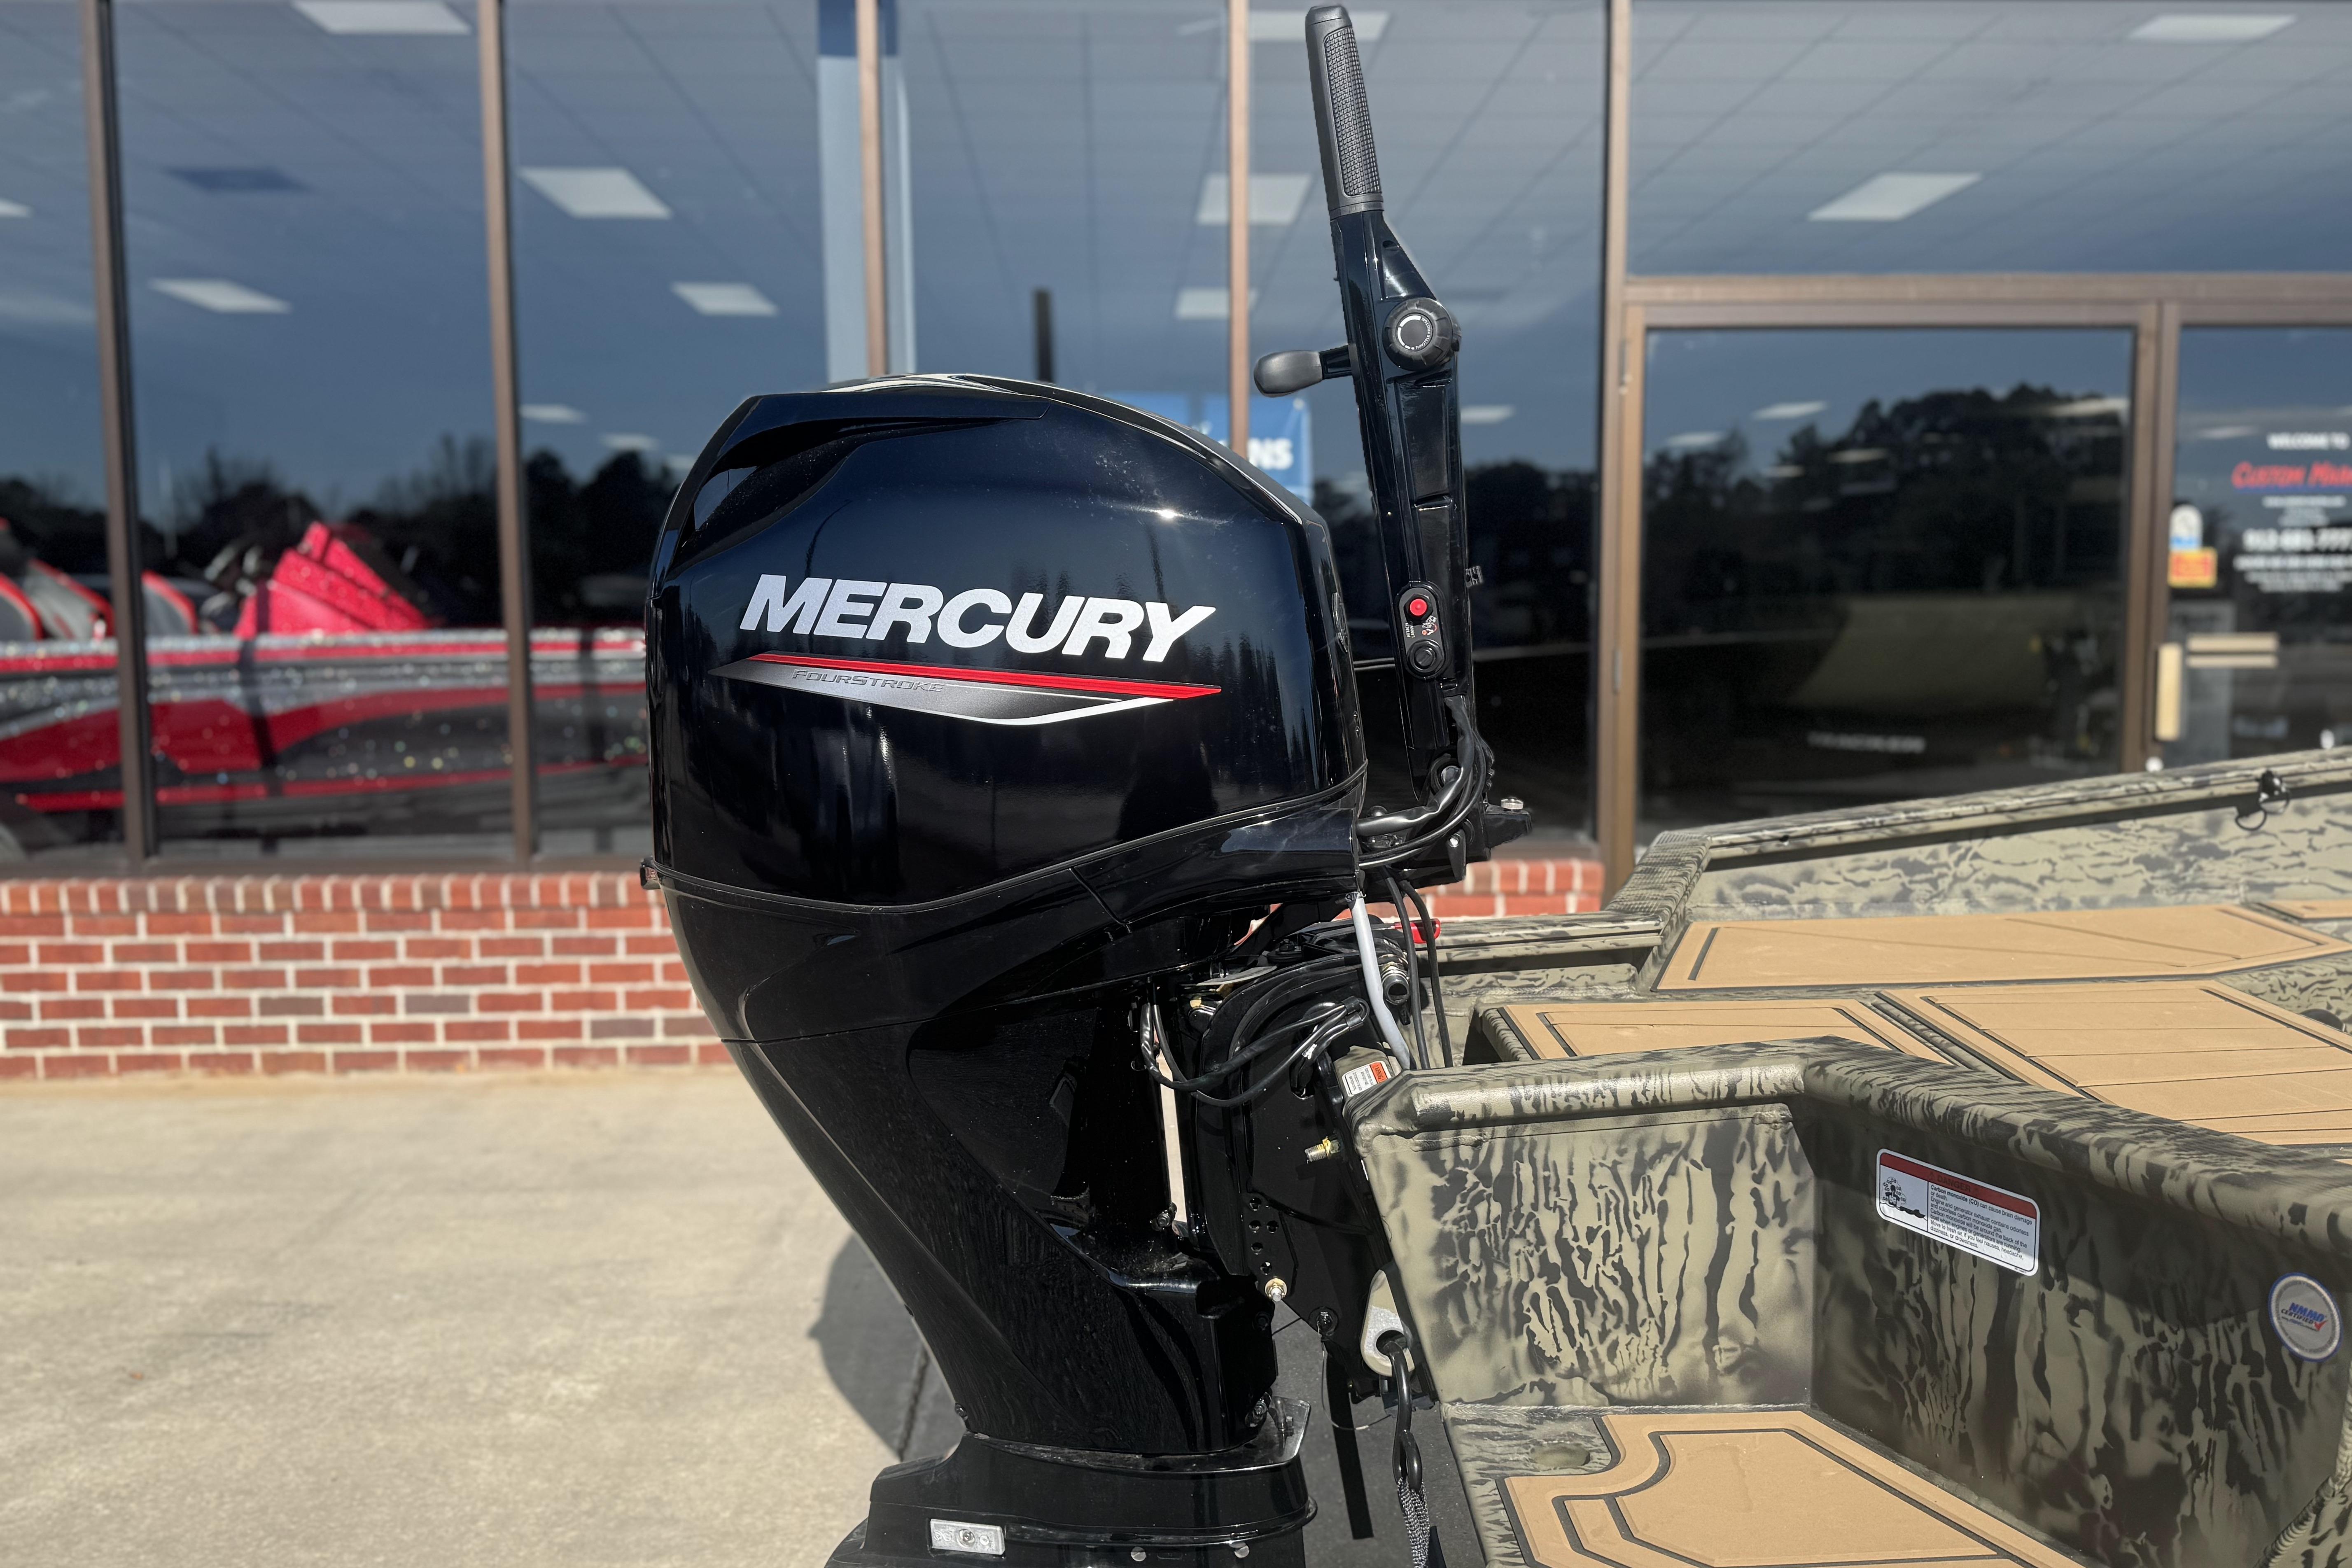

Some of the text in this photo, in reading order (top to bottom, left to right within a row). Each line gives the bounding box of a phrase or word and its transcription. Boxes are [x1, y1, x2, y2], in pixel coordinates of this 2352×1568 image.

[740, 574, 1216, 662] MERCURY
[792, 669, 945, 692] FOURSTROKE
[1937, 1174, 1971, 1192] DANGER
[1931, 1185, 1946, 1195] Carbon
[1969, 1198, 1979, 1207] (CO)
[2002, 1210, 2014, 1218] brain
[2281, 1309, 2314, 1324] CERTIFIED
